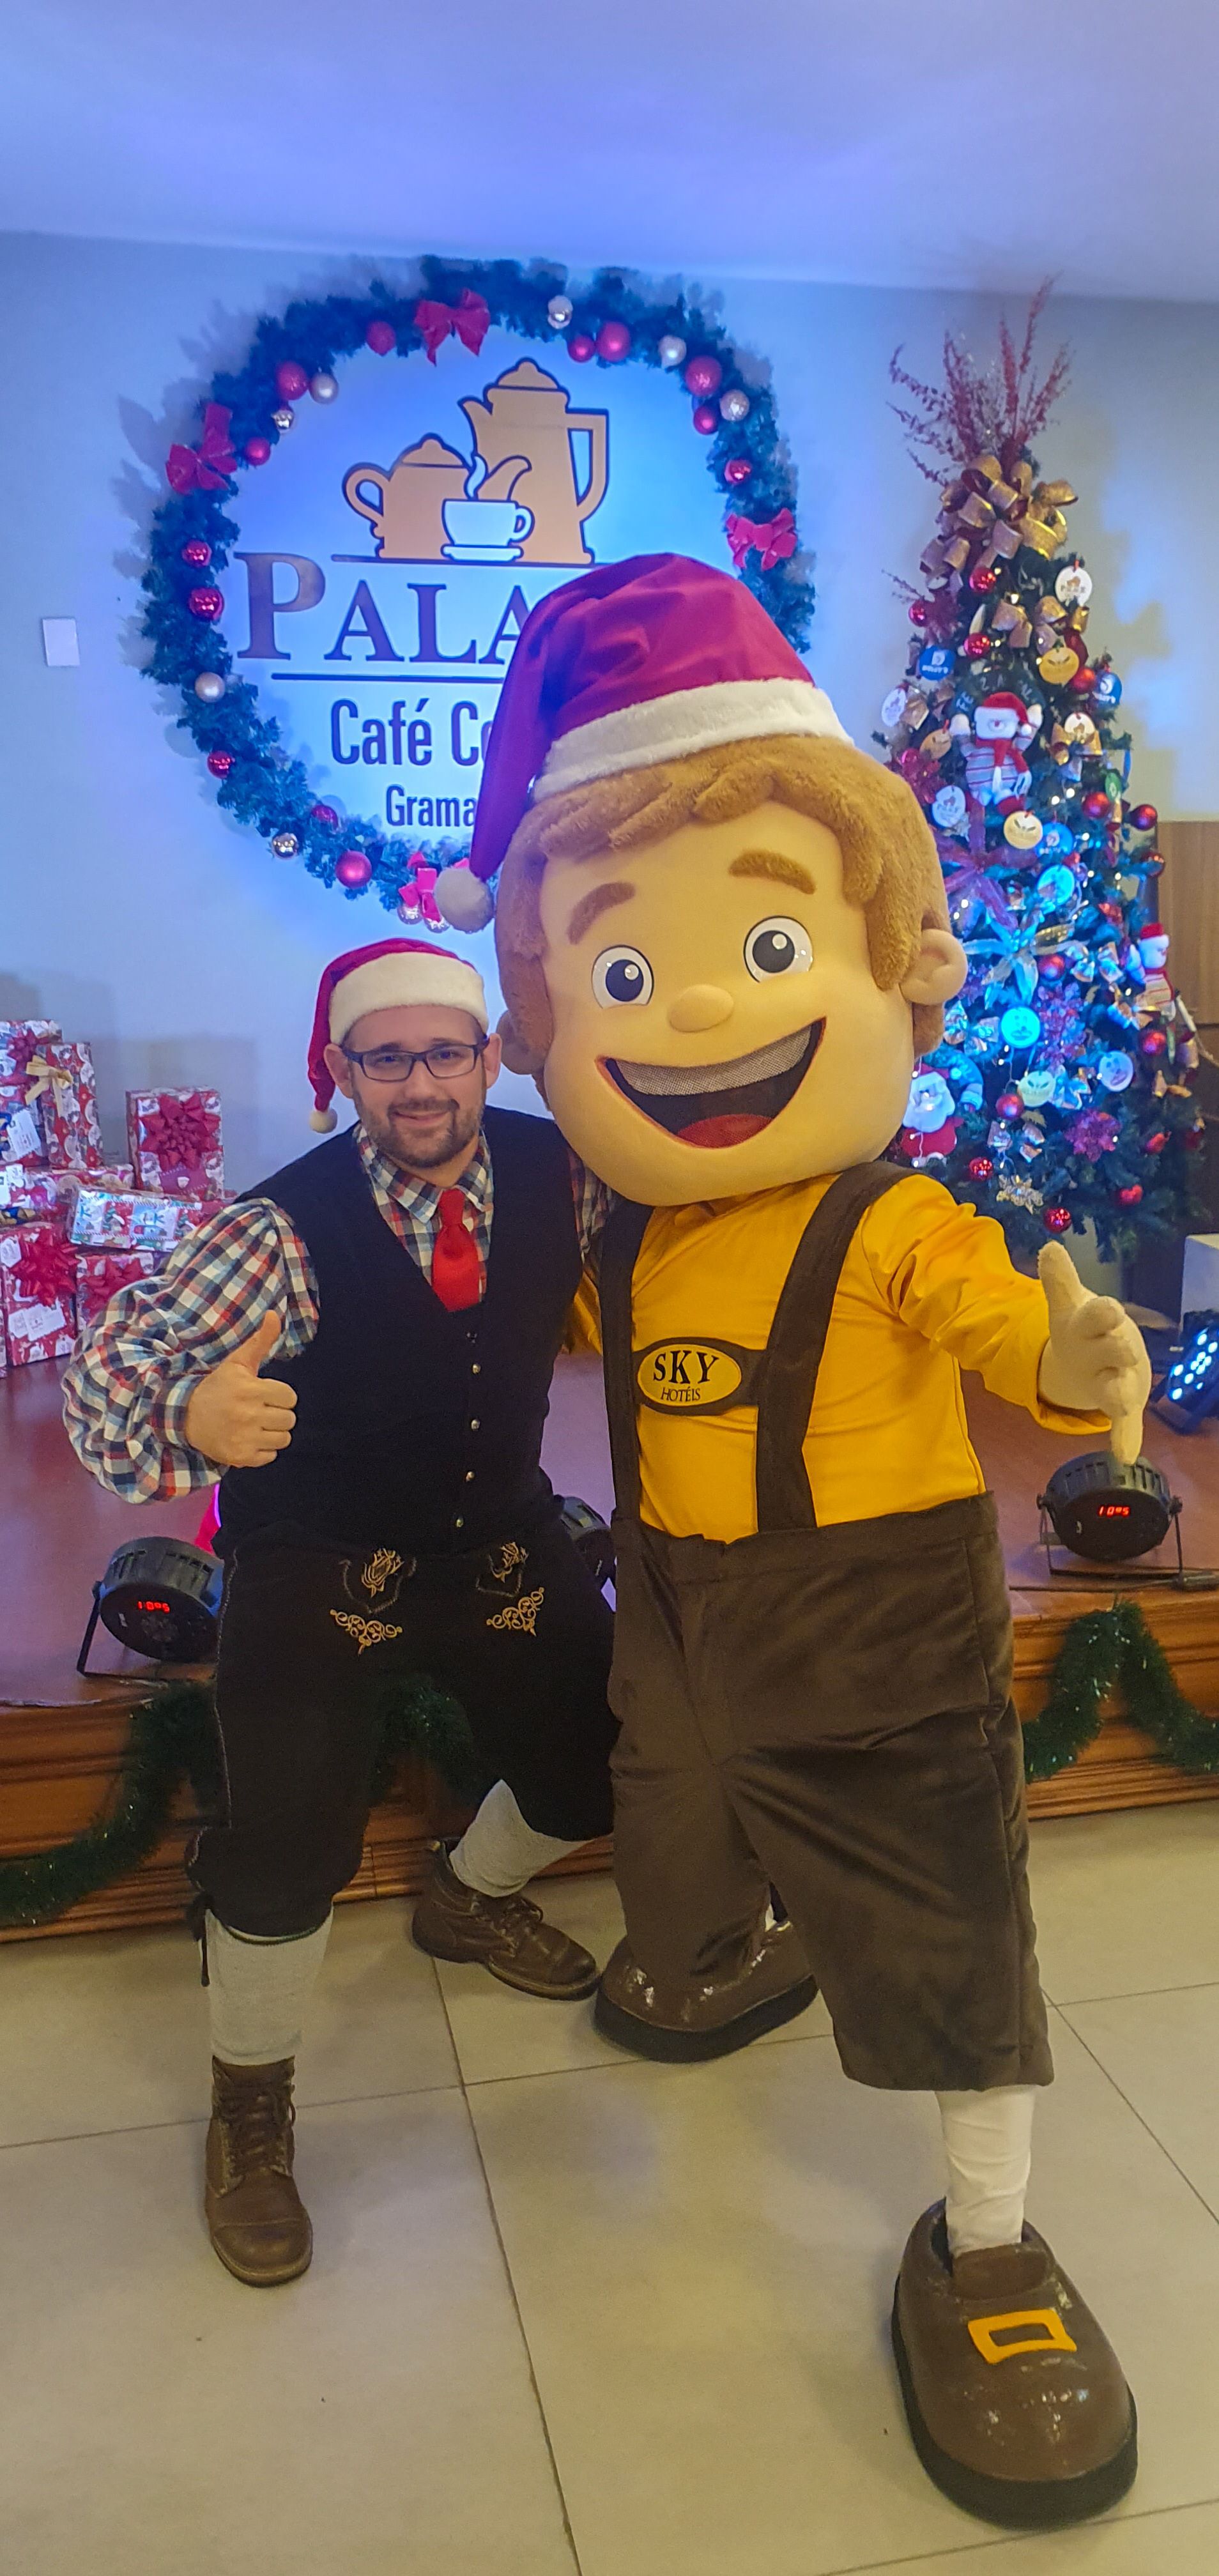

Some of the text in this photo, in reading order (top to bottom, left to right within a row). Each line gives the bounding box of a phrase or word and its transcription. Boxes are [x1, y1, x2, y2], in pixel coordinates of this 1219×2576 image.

[331, 698, 432, 765] Café
[386, 784, 478, 827] Grama
[653, 1349, 719, 1384] SKY
